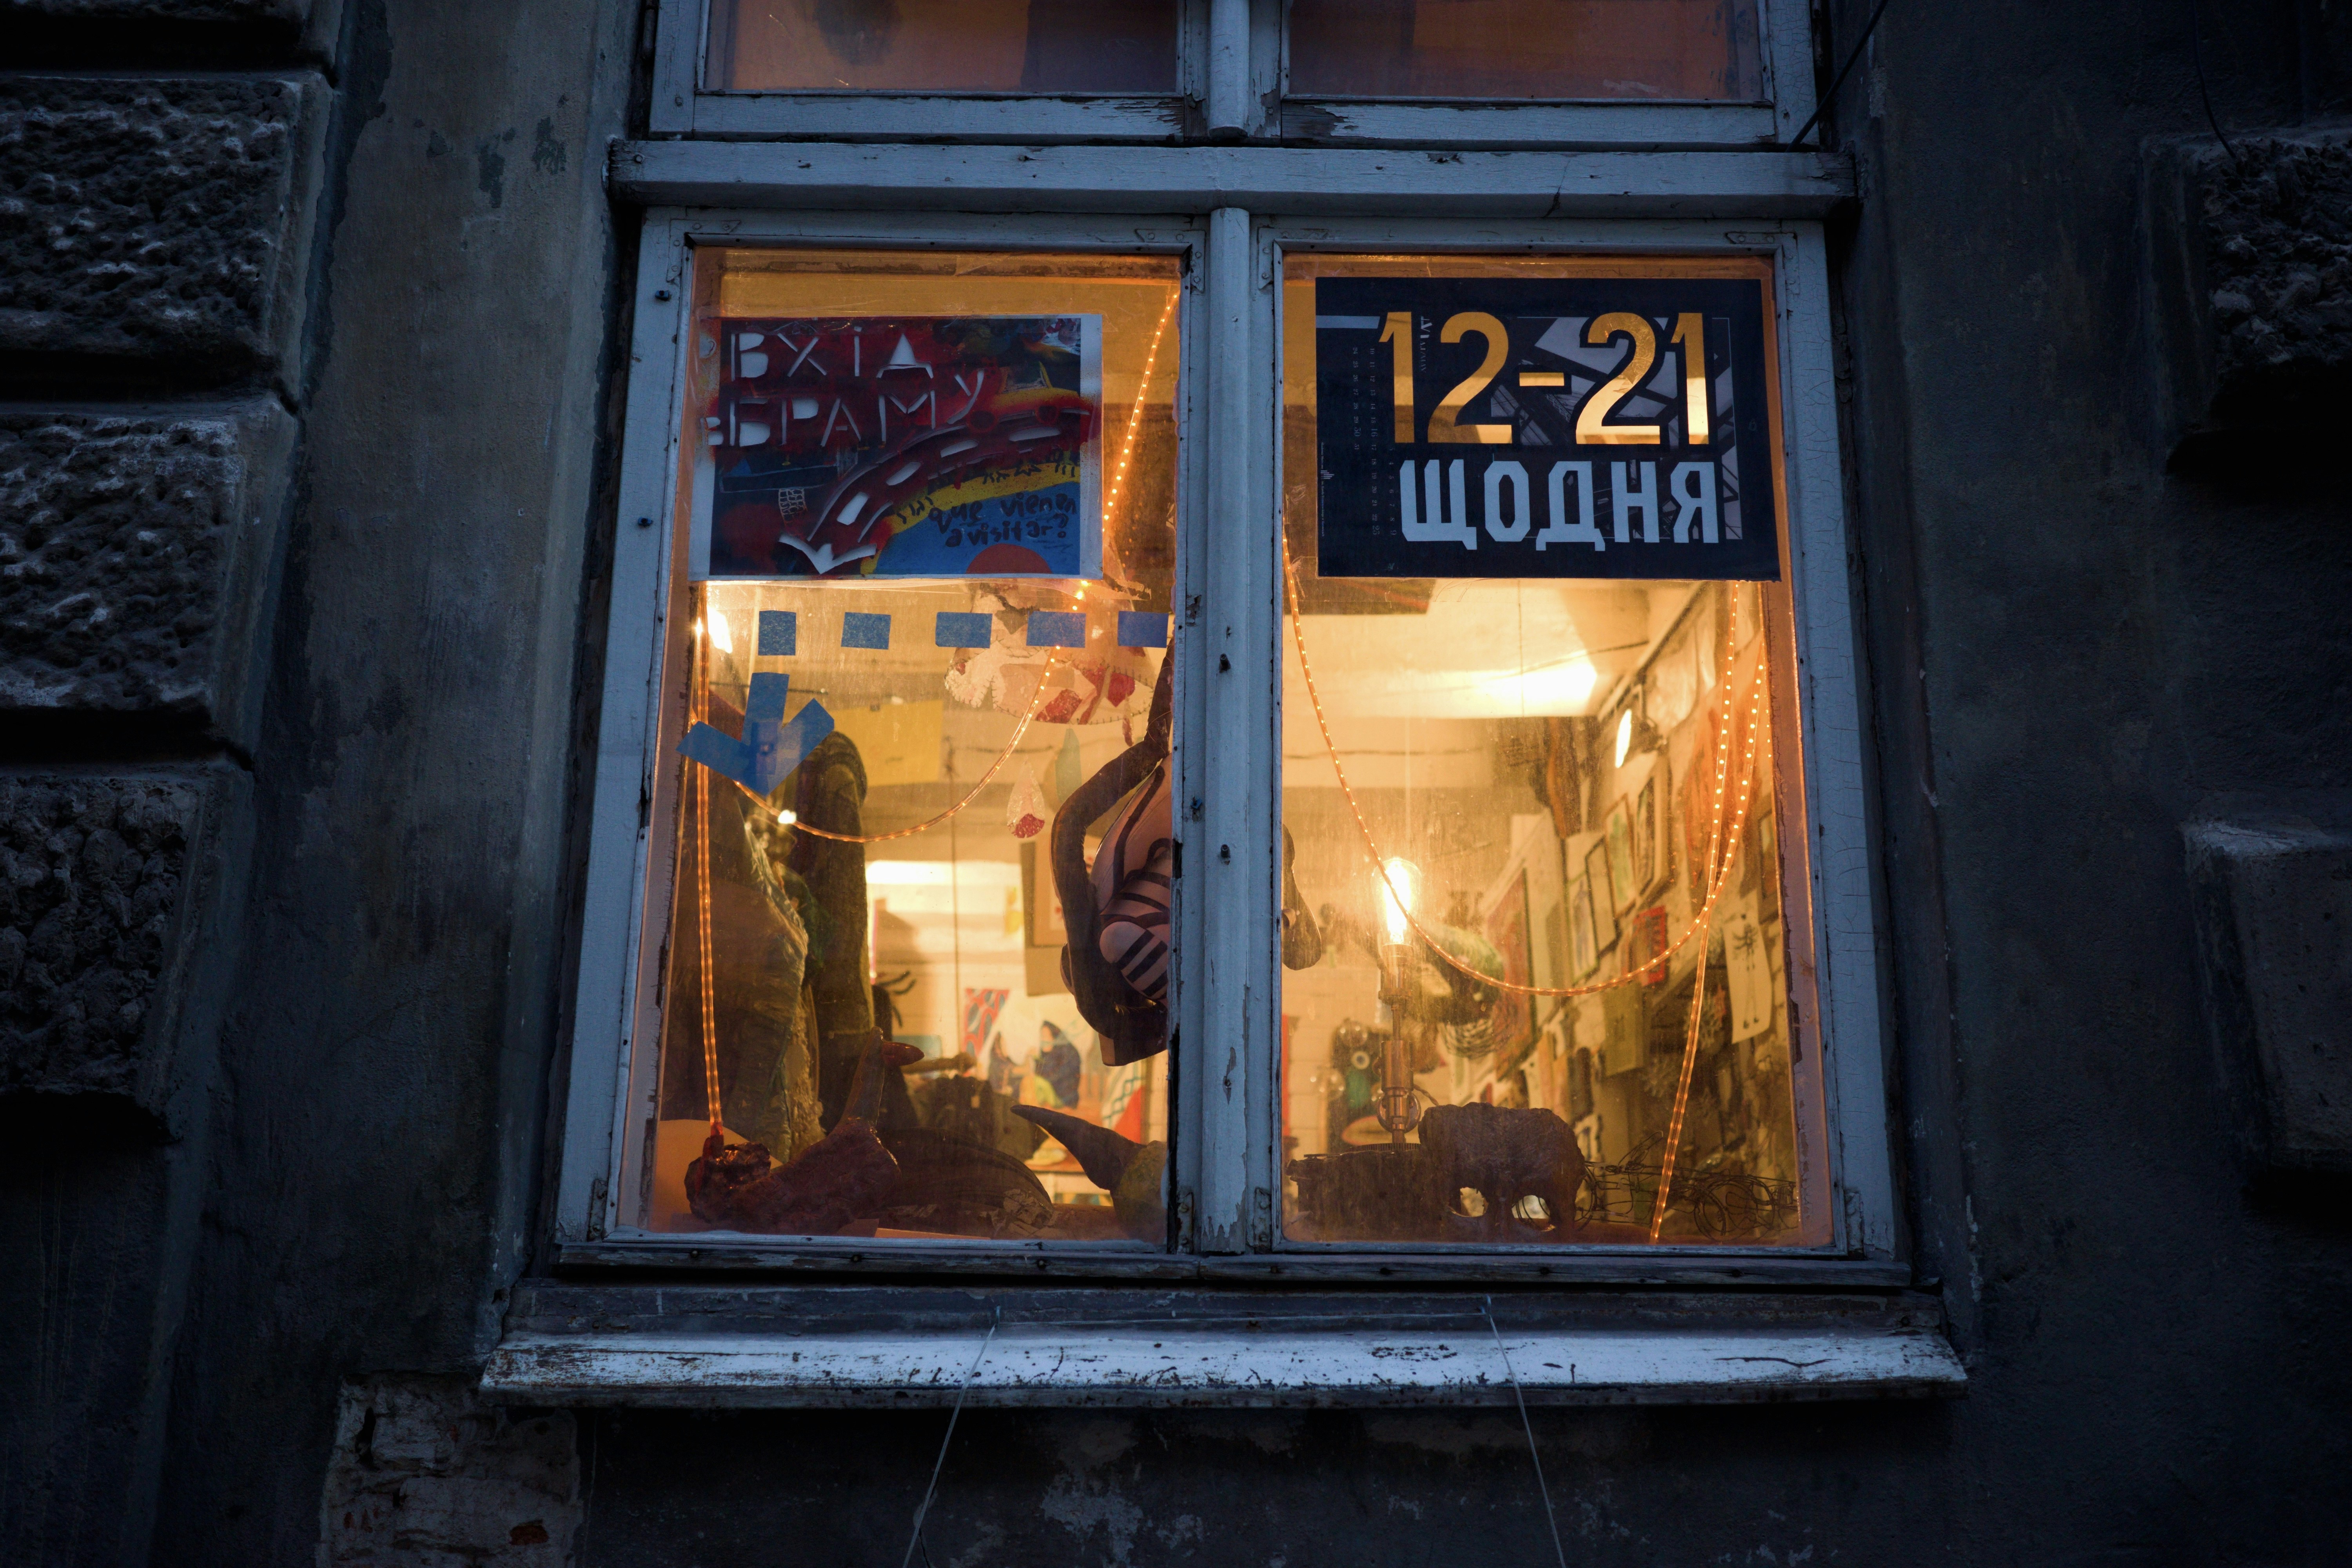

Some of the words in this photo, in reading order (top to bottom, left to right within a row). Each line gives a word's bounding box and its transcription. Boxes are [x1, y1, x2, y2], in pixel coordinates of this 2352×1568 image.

[731, 327, 934, 381] ВХІД
[1379, 311, 1709, 444] 12-21
[730, 369, 985, 447] БРАМУ
[1371, 428, 1378, 437] 16
[928, 501, 982, 534] que
[1000, 492, 1077, 517] vienen
[1400, 459, 1719, 551] ЩОДНЯ
